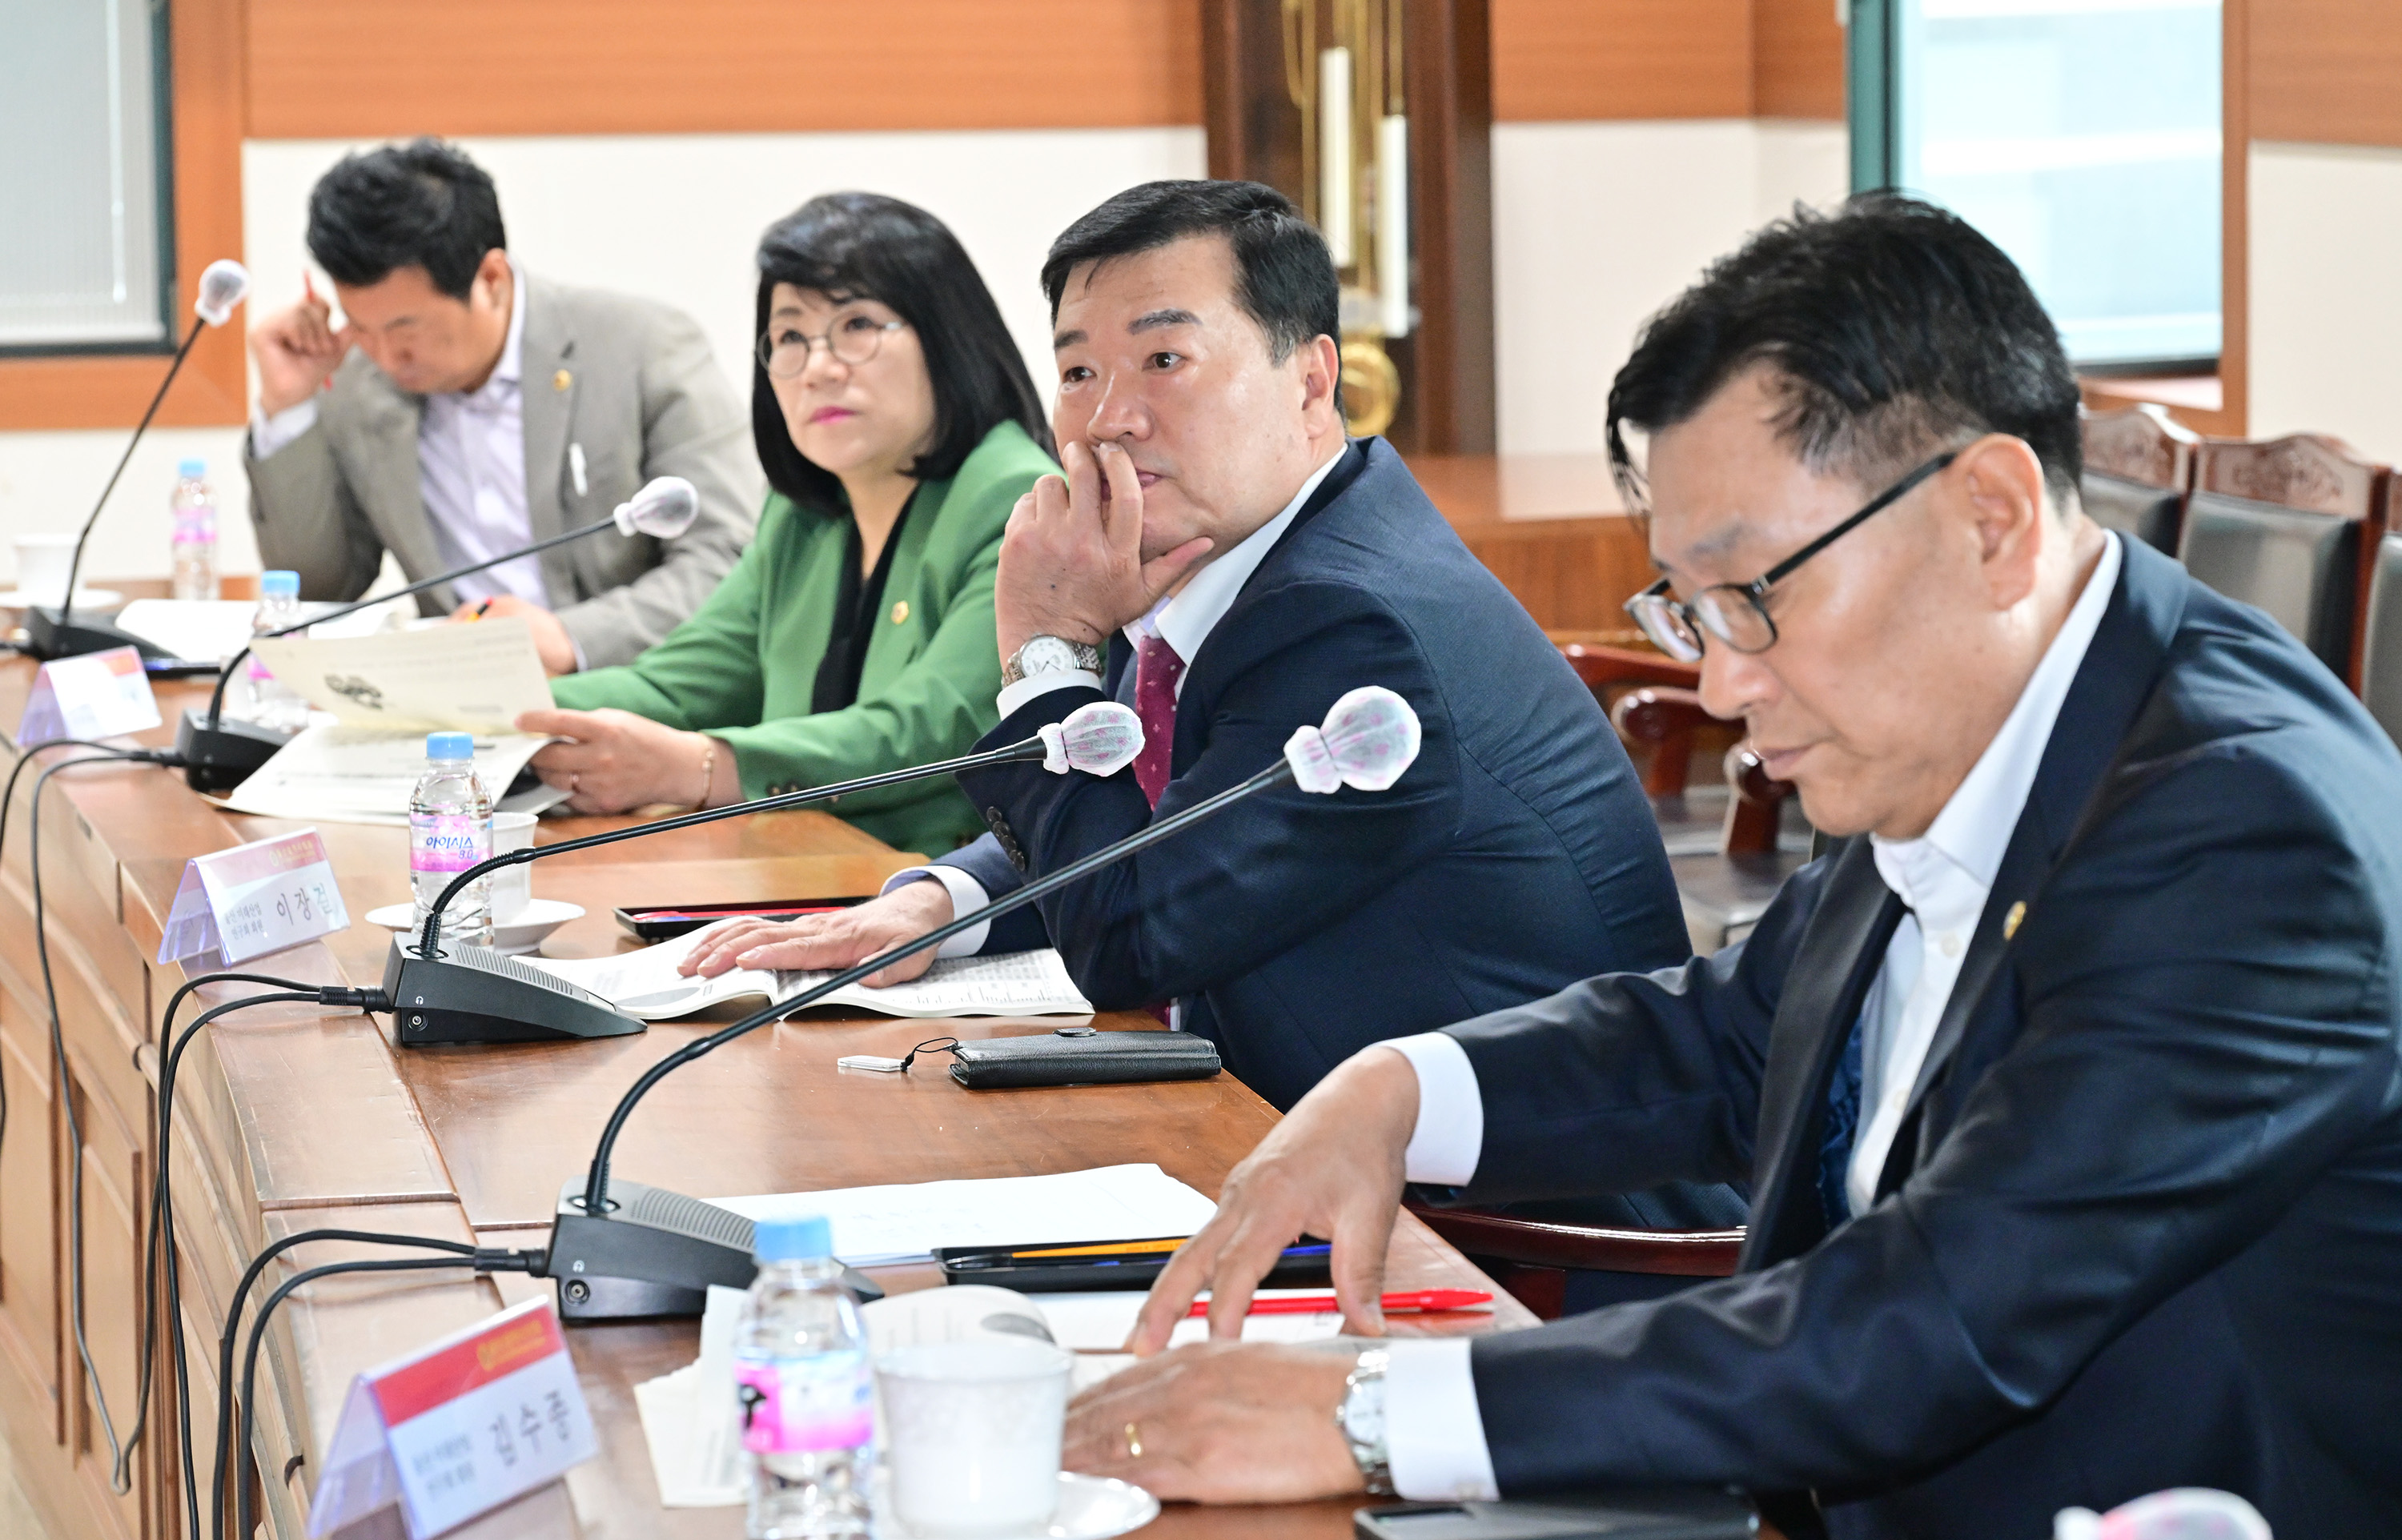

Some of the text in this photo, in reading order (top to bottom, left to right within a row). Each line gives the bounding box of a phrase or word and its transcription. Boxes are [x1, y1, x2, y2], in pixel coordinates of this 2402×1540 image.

[426, 836, 473, 849] 아이시스
[459, 849, 473, 859] 8.0
[231, 918, 264, 940] 연구회 회원
